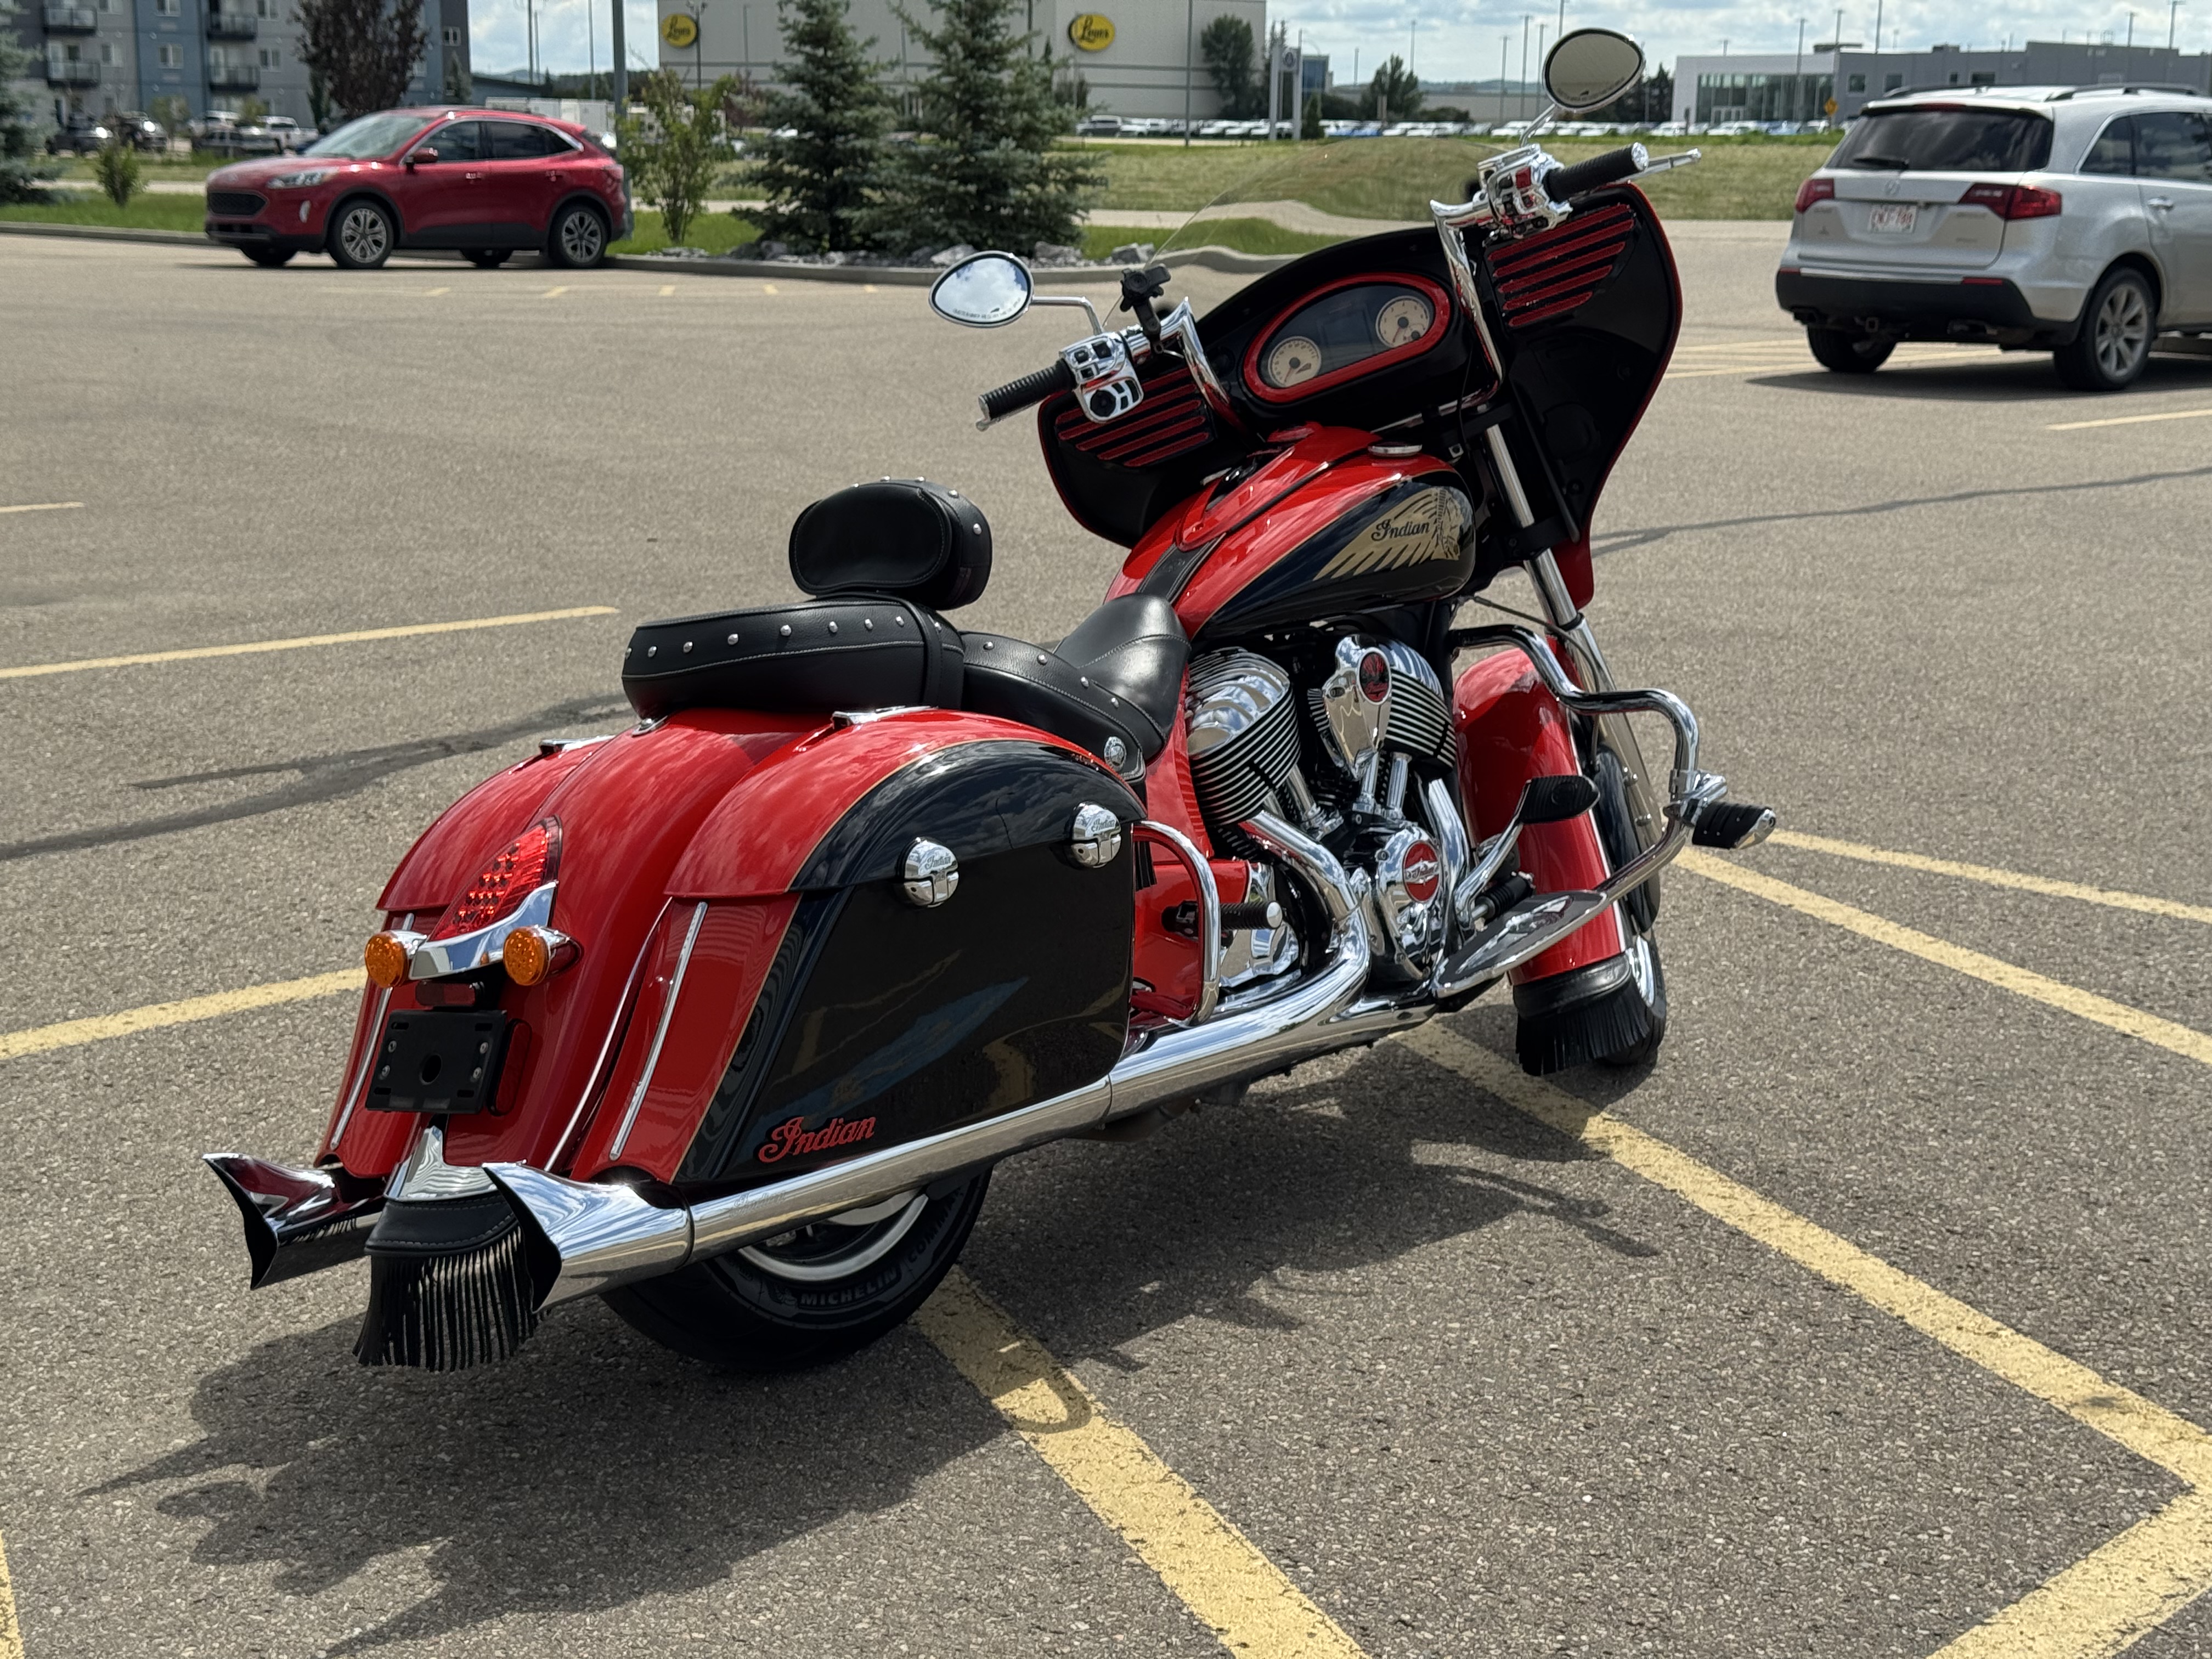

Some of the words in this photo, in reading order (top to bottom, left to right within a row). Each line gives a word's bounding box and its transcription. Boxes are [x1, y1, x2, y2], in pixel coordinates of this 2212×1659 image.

[1371, 518, 1430, 541] Indian
[1091, 815, 1115, 832] Indian
[924, 851, 951, 870] Indian
[758, 1116, 877, 1163] Indian
[800, 1267, 898, 1305] MICHELIN
